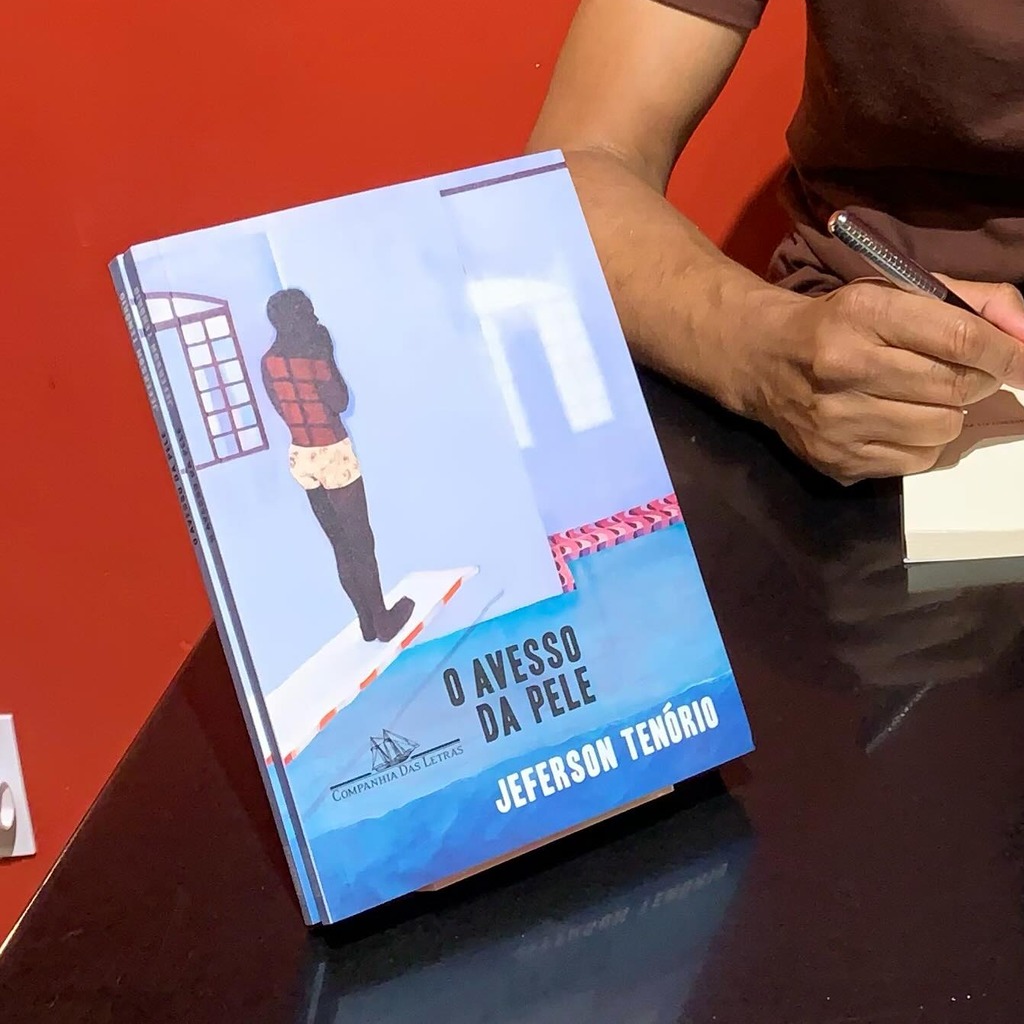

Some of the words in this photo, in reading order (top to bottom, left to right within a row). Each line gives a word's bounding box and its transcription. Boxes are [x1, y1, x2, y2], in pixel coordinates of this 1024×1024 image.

[443, 667, 465, 707] O
[472, 625, 582, 699] AVESSO
[476, 696, 521, 743] DA
[525, 666, 597, 724] PELE
[495, 736, 619, 814] JEFERSON
[620, 695, 719, 761] TENÓRIO
